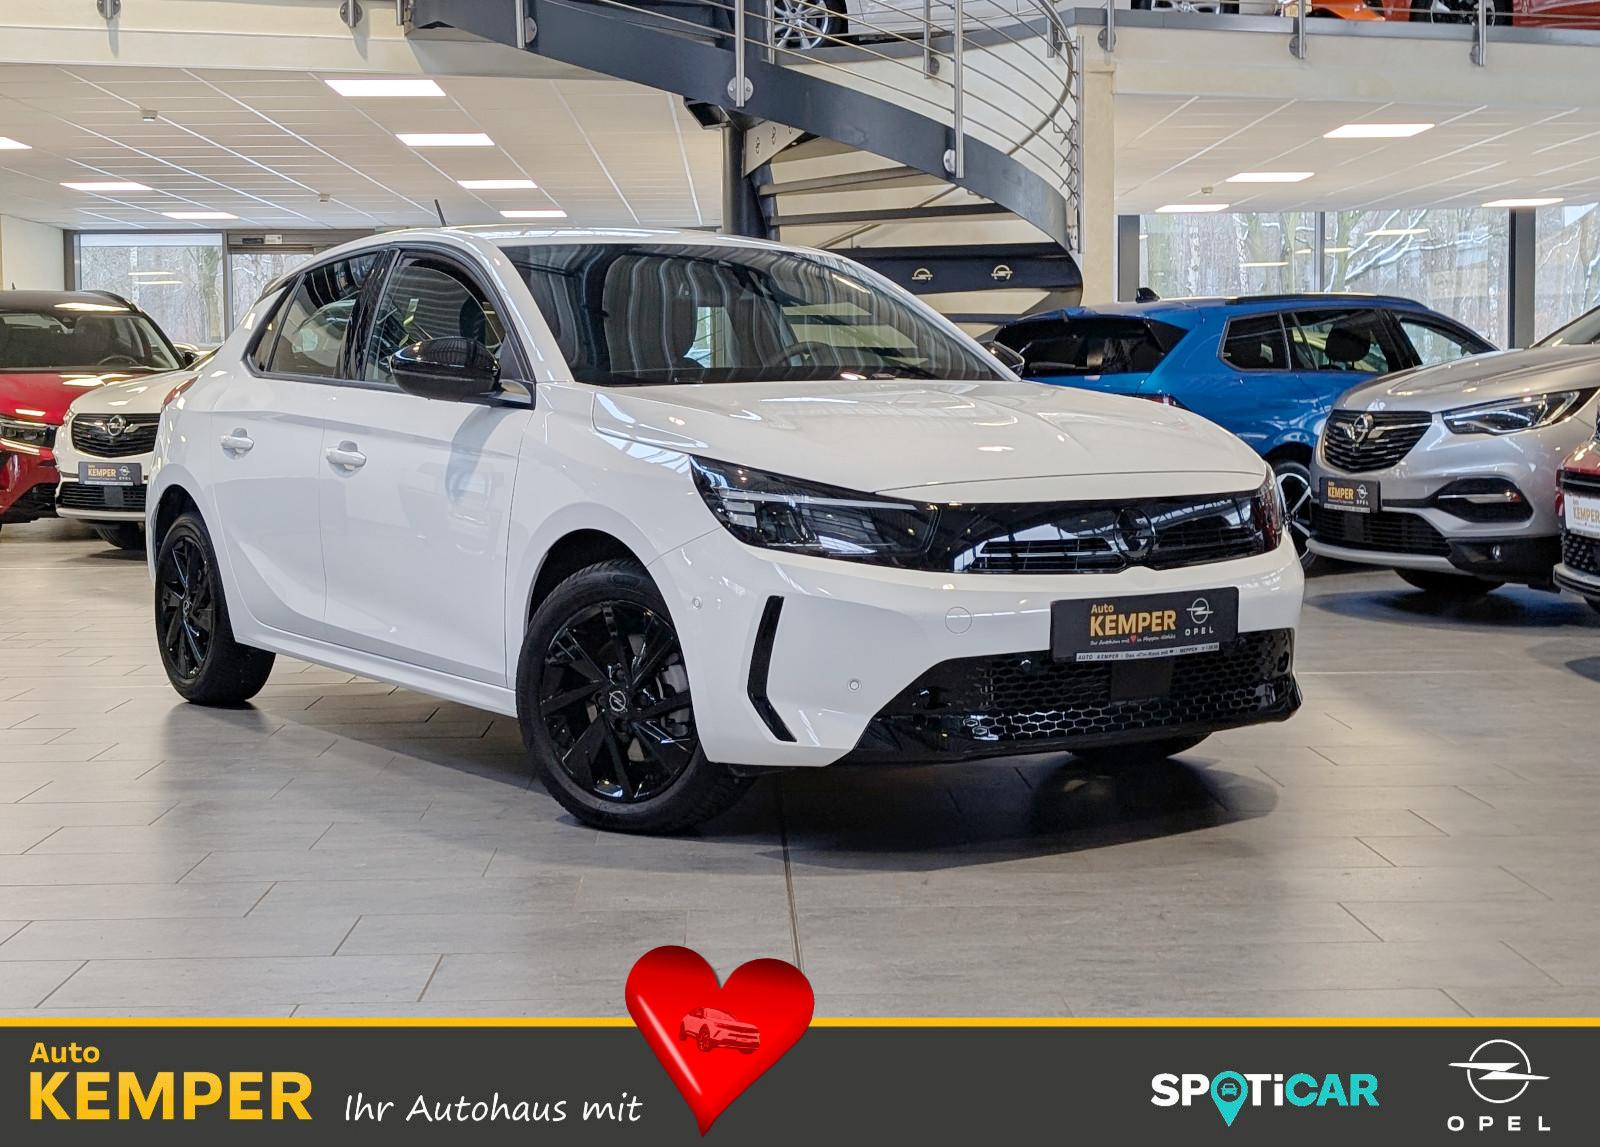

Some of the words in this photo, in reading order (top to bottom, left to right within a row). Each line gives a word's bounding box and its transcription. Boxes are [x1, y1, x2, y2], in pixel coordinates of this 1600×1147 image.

[88, 468, 116, 477] KEMPER
[1328, 486, 1354, 499] KEMPER
[1091, 603, 1114, 614] Auto
[1090, 610, 1177, 637] KEMPER
[1185, 626, 1214, 637] OPEL
